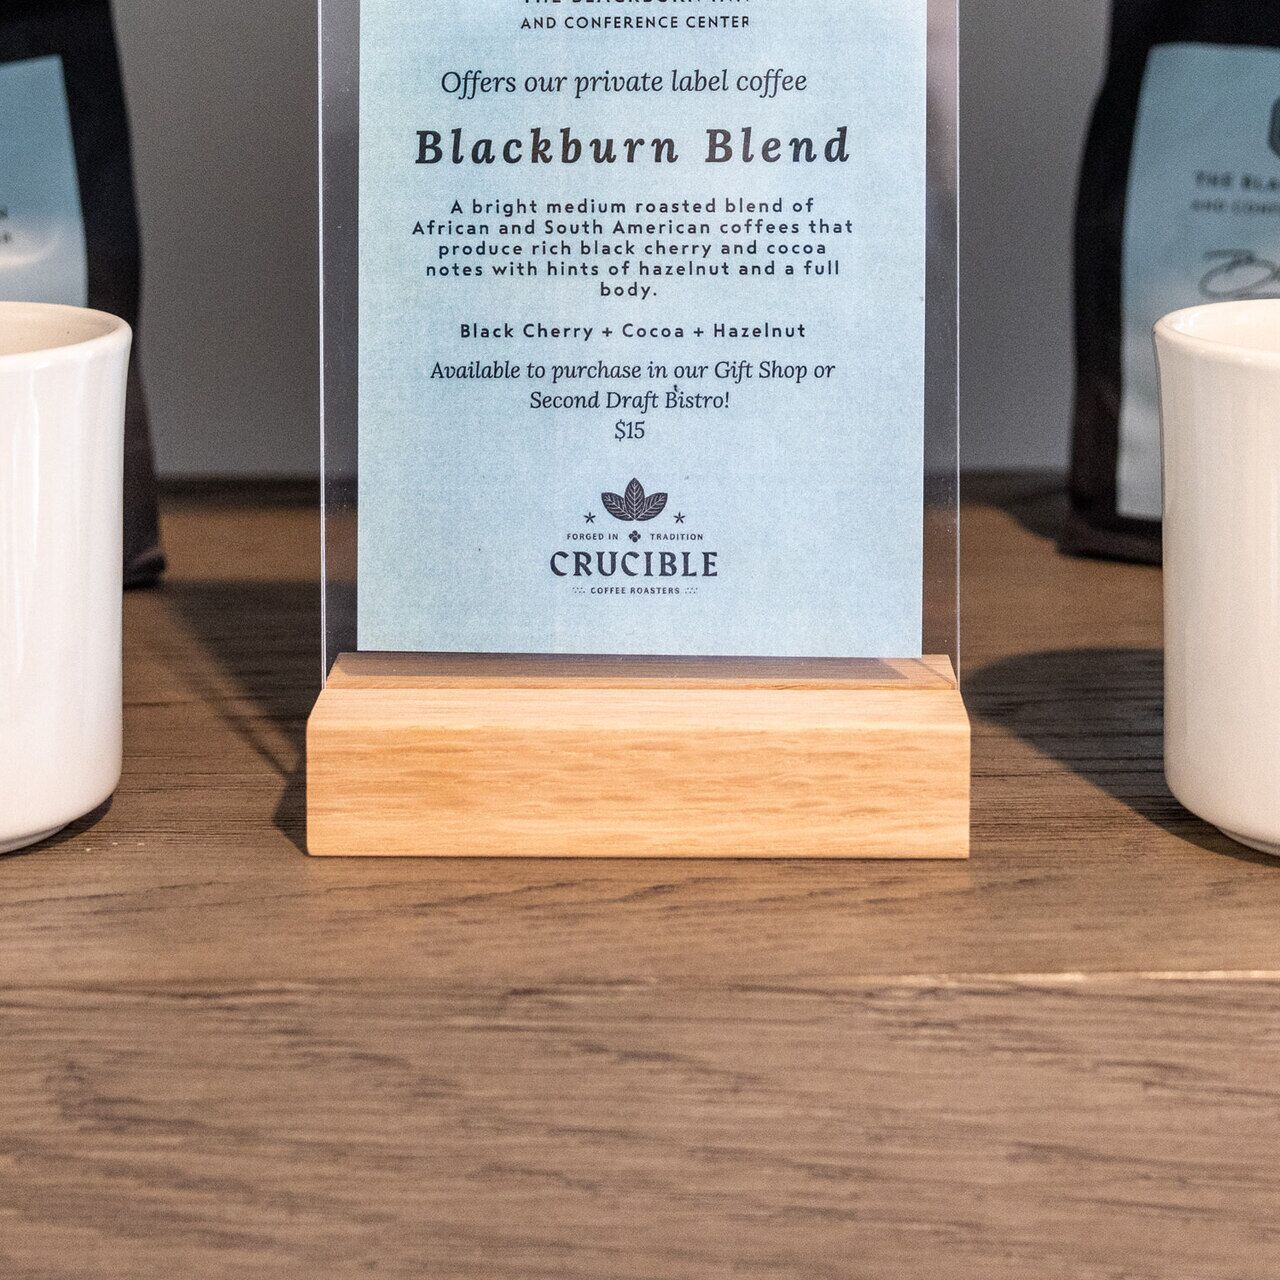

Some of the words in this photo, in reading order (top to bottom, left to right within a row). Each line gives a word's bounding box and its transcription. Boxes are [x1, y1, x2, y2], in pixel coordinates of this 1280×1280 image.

[521, 17, 556, 29] AND
[565, 16, 677, 29] CONFERENCE
[686, 16, 749, 28] CENTER
[441, 70, 516, 100] Offers
[525, 77, 567, 92] our
[575, 70, 663, 99] private
[672, 69, 728, 91] label
[736, 69, 807, 98] coffee
[415, 127, 678, 164] Blackburn
[705, 126, 849, 162] Blend
[451, 200, 463, 214] A
[473, 199, 537, 217] bright
[547, 198, 625, 213] medium
[636, 198, 715, 213] roasted
[726, 198, 782, 213] blend
[793, 197, 813, 212] of
[412, 220, 488, 235] African
[499, 219, 534, 234] and
[545, 219, 602, 234] South
[613, 220, 709, 234] American
[720, 219, 799, 234] coffees
[809, 219, 852, 233] that
[439, 241, 522, 259] produce
[532, 241, 571, 255] rich
[581, 240, 634, 255] black
[645, 240, 711, 258] cherry
[721, 240, 756, 254] and
[767, 244, 825, 254] cocoa
[426, 263, 482, 276] notes
[492, 261, 537, 276] with
[547, 261, 598, 276] hints
[609, 260, 629, 275] of
[640, 261, 729, 276] hazelnut
[739, 260, 774, 275] and
[785, 265, 794, 275] a
[804, 260, 839, 275] full
[601, 282, 656, 300] body.
[461, 323, 513, 338] Black
[523, 323, 593, 341] Cherry
[602, 328, 612, 337] +
[622, 323, 684, 338] Cocoa
[694, 328, 703, 337] +
[714, 322, 805, 337] Hazelnut
[430, 361, 520, 379] Available
[527, 363, 545, 378] to
[552, 360, 641, 384] purchase
[647, 361, 667, 378] in
[674, 366, 708, 378] our
[714, 360, 753, 384] Gift
[759, 360, 807, 384] Shop
[814, 365, 835, 378] or
[530, 391, 600, 409] Second
[606, 391, 658, 414] Draft
[666, 391, 729, 410] Bistro!
[615, 420, 645, 441] $15
[550, 551, 717, 577] CRUCIBLE
